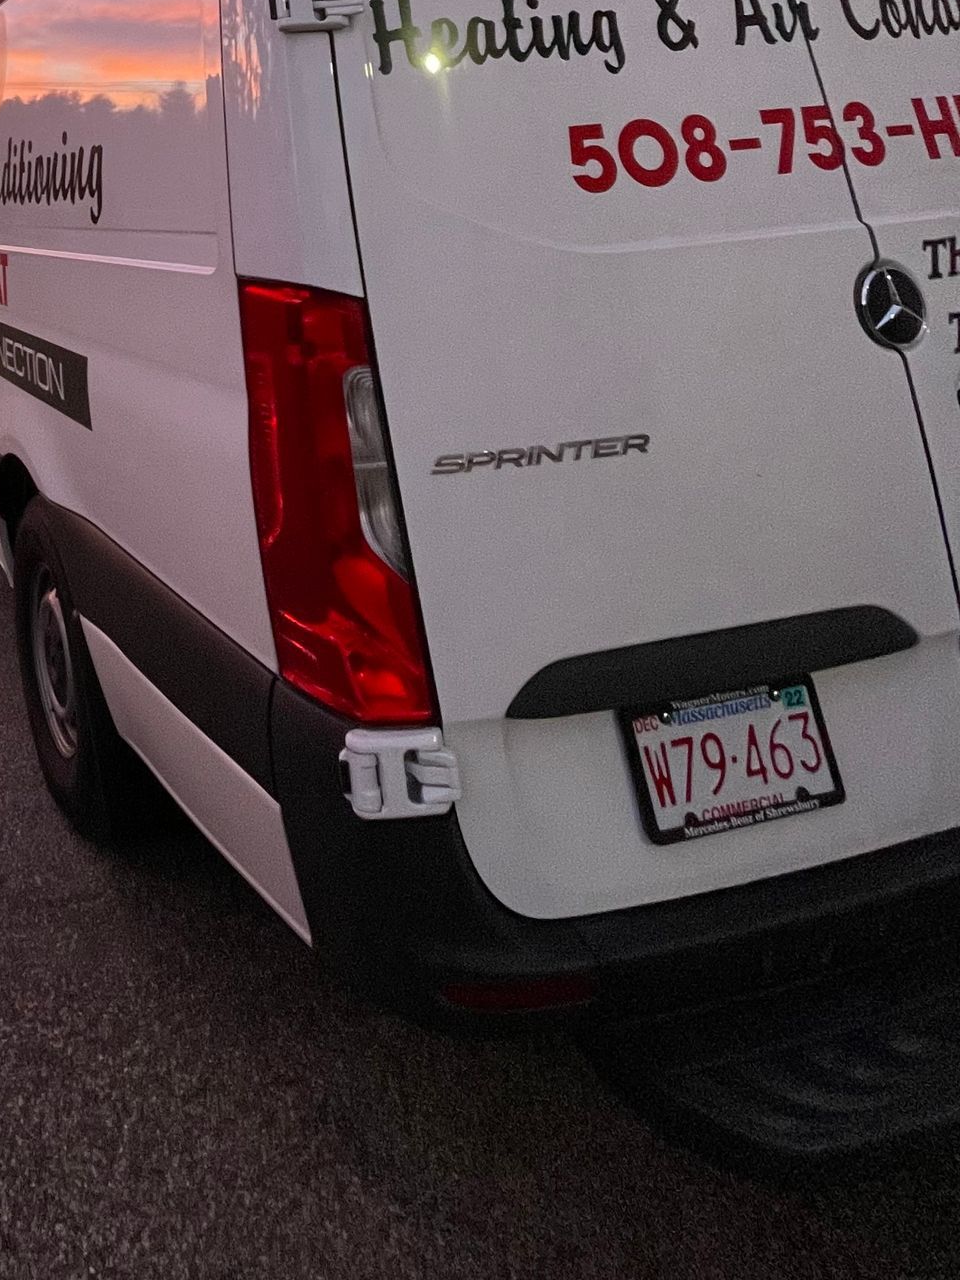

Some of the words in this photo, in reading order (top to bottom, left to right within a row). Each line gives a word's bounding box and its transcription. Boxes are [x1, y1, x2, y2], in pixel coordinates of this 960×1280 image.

[567, 94, 960, 194] 508-753-H
[431, 433, 651, 476] SPRINTER
[784, 688, 805, 707] 22
[634, 715, 659, 734] DEC
